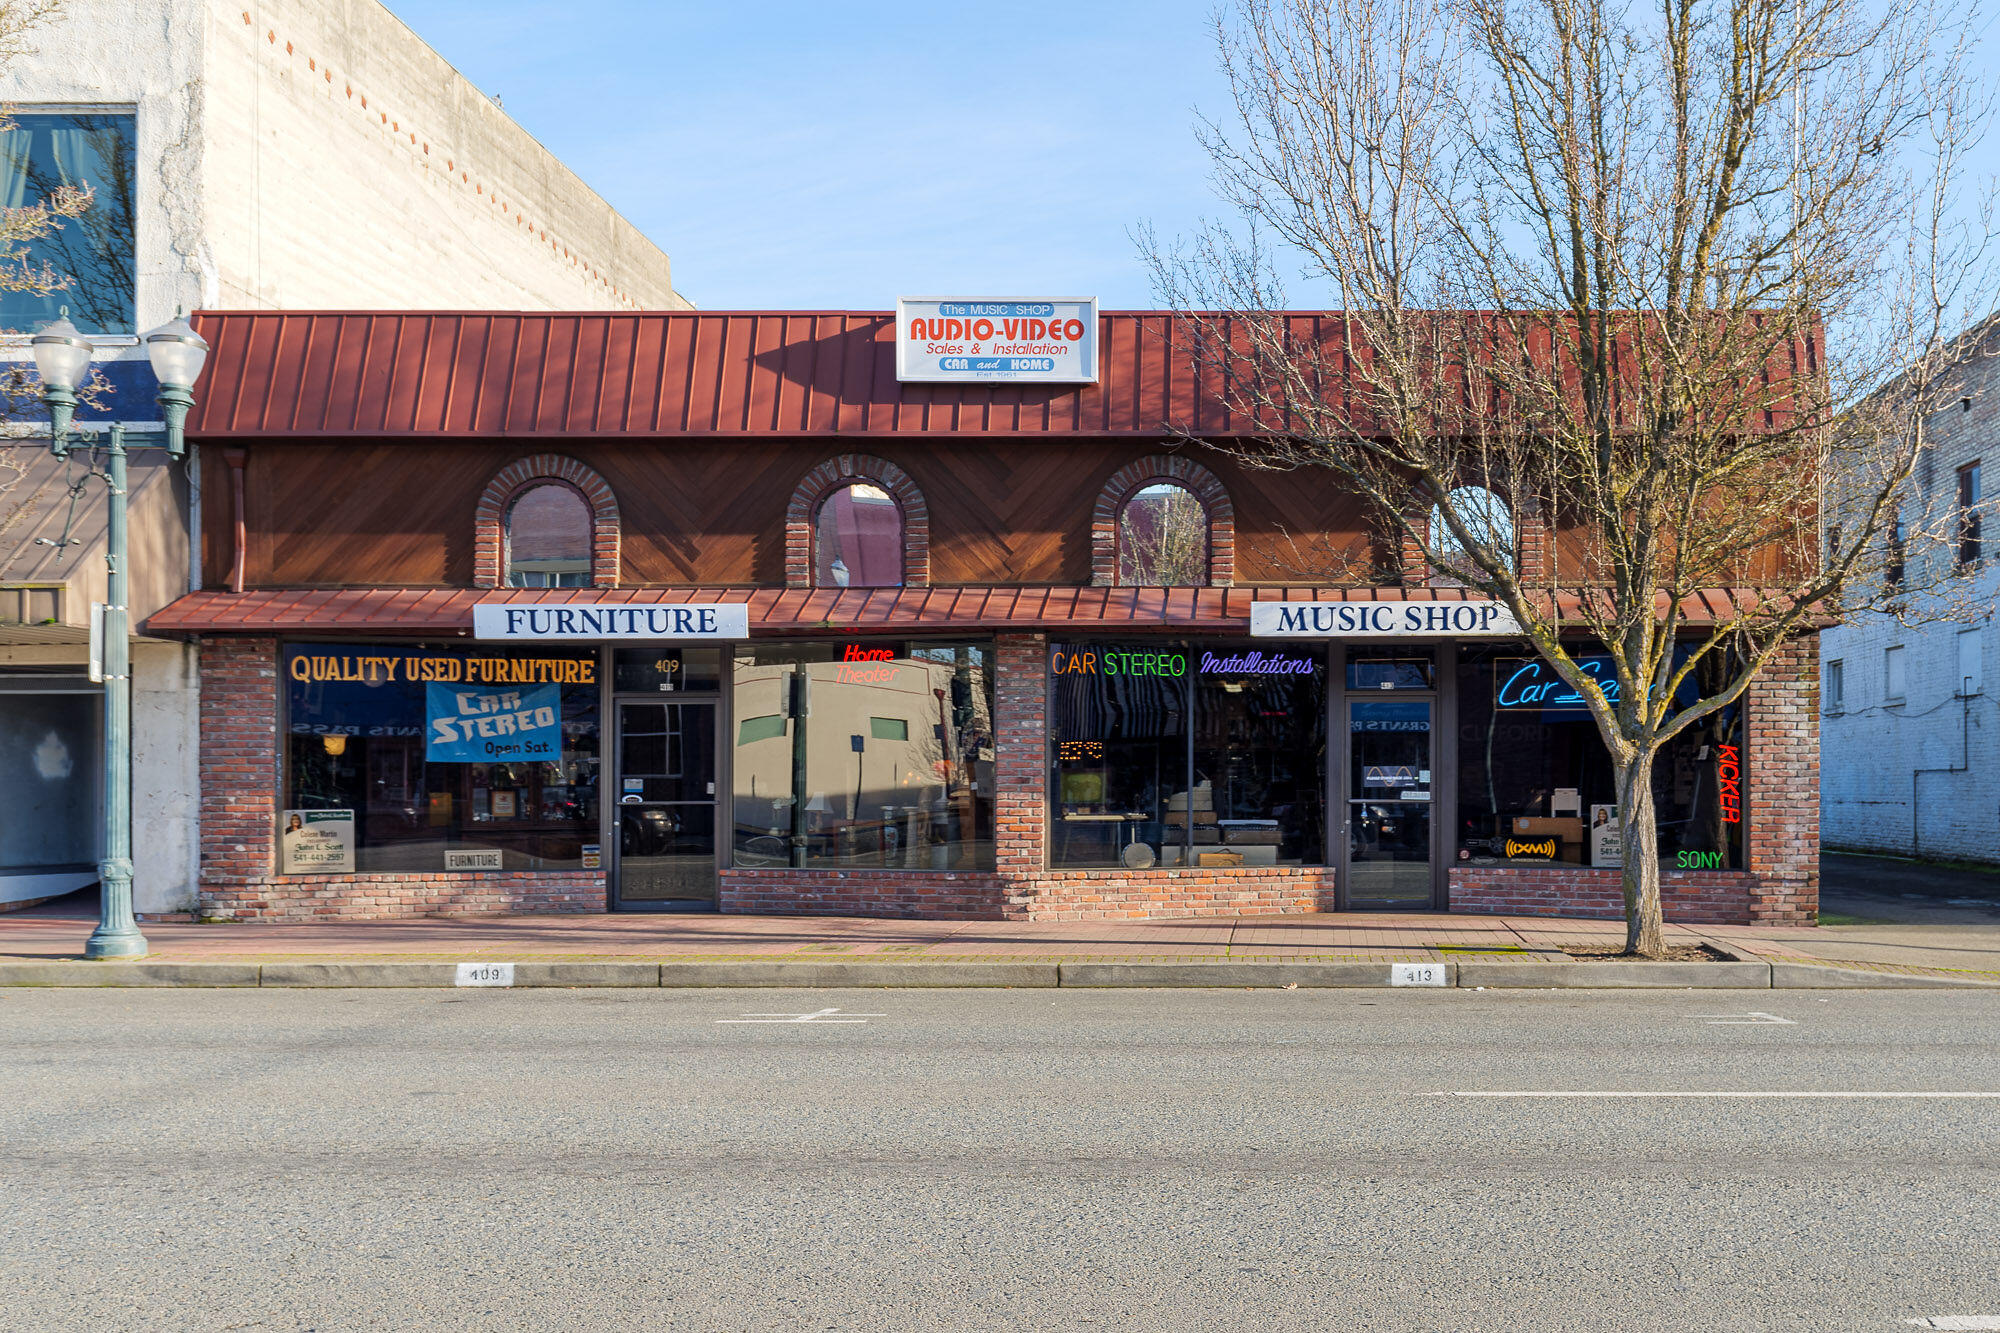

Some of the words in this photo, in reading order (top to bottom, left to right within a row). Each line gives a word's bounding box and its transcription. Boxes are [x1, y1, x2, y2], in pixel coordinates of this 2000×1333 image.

[943, 305, 965, 315] The
[970, 305, 1008, 315] MUSIC
[1016, 305, 1050, 315] SHOP
[910, 318, 1084, 341] AUDIO-VIDEO
[926, 343, 963, 355] Sales
[970, 343, 982, 355] &
[993, 343, 1068, 355] Installation
[944, 359, 969, 370] CAR
[976, 359, 1001, 369] and
[1011, 358, 1050, 370] HOME
[505, 608, 718, 634] FURNITURE
[1276, 606, 1394, 632] MUSIC
[1404, 606, 1499, 632] SHOP
[843, 645, 895, 663] Home
[1200, 651, 1314, 674] Installations
[291, 656, 401, 683] QUALITY
[405, 657, 461, 682] USED
[465, 659, 595, 684] FURNITURE
[655, 659, 679, 673] 409
[836, 664, 900, 684] Theater
[1052, 652, 1097, 675] CAR
[1104, 653, 1186, 677] STEREO
[1498, 663, 1559, 706] Car
[456, 692, 521, 715] CAR
[432, 706, 555, 744] STEREO
[485, 741, 521, 758] Open
[524, 740, 554, 753] Sat.
[1718, 744, 1740, 824] KICKER
[450, 854, 498, 867] FURNITURE
[1676, 850, 1723, 869] SONY
[470, 968, 499, 980] 409
[1406, 970, 1432, 981] 413
